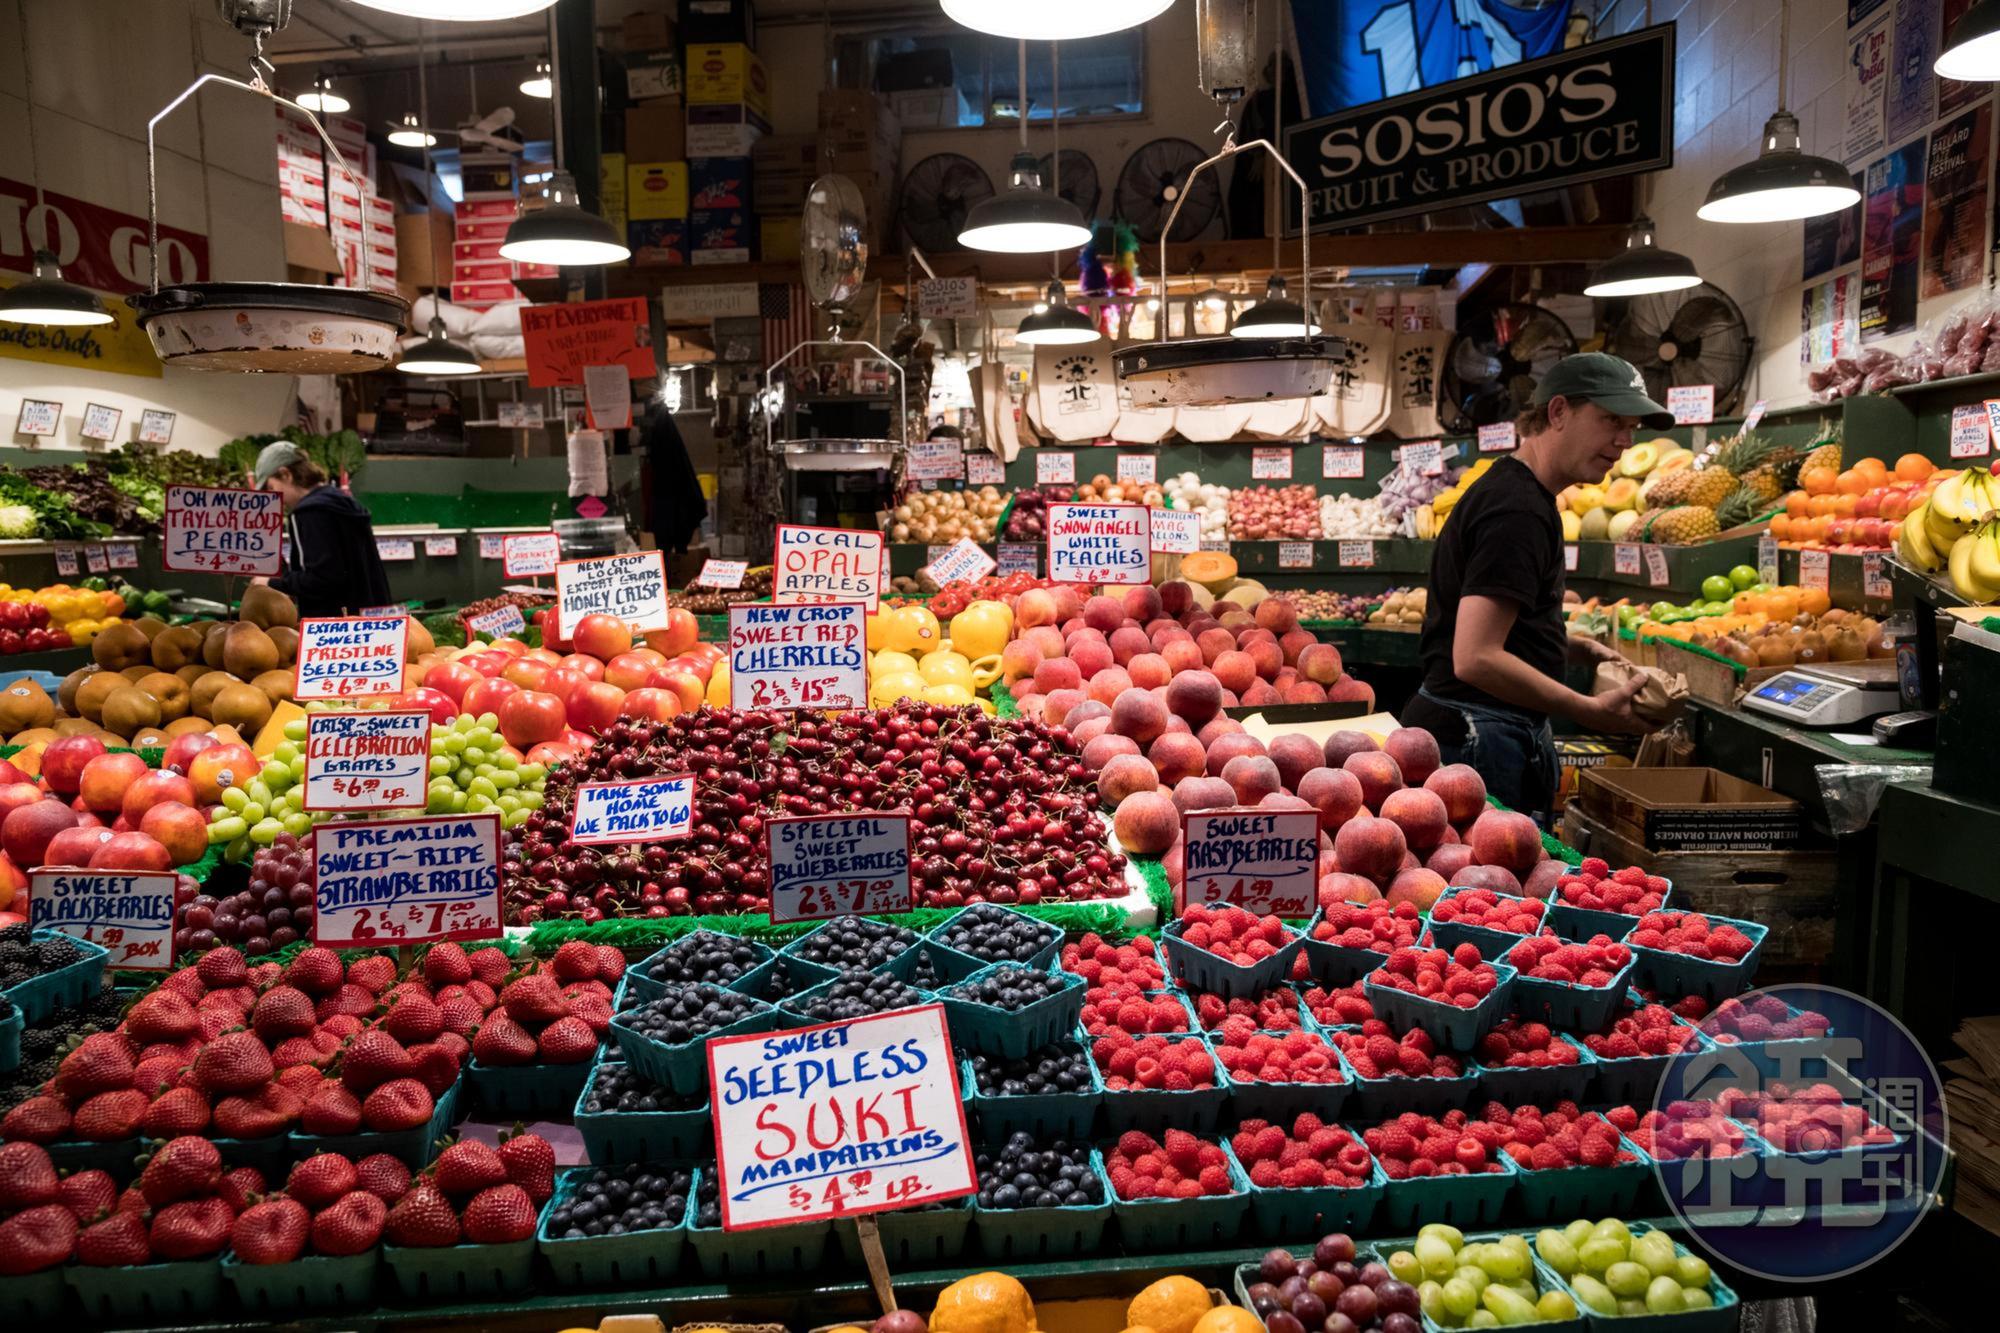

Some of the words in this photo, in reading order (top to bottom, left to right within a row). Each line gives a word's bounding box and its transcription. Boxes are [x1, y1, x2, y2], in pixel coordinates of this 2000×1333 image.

[1319, 61, 1617, 178] SOSIO'S
[1931, 127, 1969, 156] BALLARD
[1308, 171, 1405, 218] FRUIT
[1412, 167, 1438, 195] &
[1445, 120, 1641, 190] PRODUCE
[1929, 153, 1967, 181] FESTIVAL
[109, 226, 199, 287] GO
[212, 493, 237, 511] MY
[1066, 507, 1121, 518] SWEET
[167, 508, 238, 531] TAYLOR
[243, 511, 282, 536] GOLD
[1152, 511, 1198, 520] AGNIFICENT
[1053, 519, 1092, 536] SNOW
[1094, 520, 1146, 536] ANGEL
[182, 530, 264, 551] PEARS
[782, 530, 877, 549] LOCAL
[1068, 536, 1122, 548] WHITE
[577, 561, 605, 573] NEW
[611, 555, 646, 568] CROP
[785, 549, 877, 577] OPAL
[1052, 548, 1144, 566] PEACHES
[566, 577, 614, 595] EXPORT
[619, 568, 662, 586] GRADE
[588, 566, 634, 580] LOCAL
[786, 574, 870, 592] APPLES
[563, 590, 610, 613] HONEY
[615, 582, 662, 605] CRISP
[747, 608, 790, 623] NEW
[797, 607, 854, 621] CROP
[307, 622, 349, 635] EXTRA
[353, 619, 403, 632] CRISP
[733, 623, 808, 649] SWEET
[814, 624, 859, 647] RED
[316, 632, 374, 647] SWEET
[304, 643, 396, 662] PRISTINE
[734, 644, 862, 673] CHERRIES
[303, 659, 397, 677] SEEDLESS
[752, 679, 772, 707] 2
[310, 728, 430, 761] CELEBRATION
[324, 758, 396, 773] GRAPES
[1558, 755, 1605, 767] above
[382, 788, 410, 803] LB.
[586, 786, 633, 802] TAKE
[637, 780, 686, 799] SOME
[606, 796, 661, 816] HOME
[575, 818, 600, 835] WE
[606, 812, 650, 831] PACK
[652, 809, 669, 827] TO
[669, 805, 690, 825] GO
[781, 820, 888, 843] SPECIAL
[1206, 816, 1278, 839] SWEET
[332, 822, 477, 849] PREMIUM
[1653, 830, 1705, 840] ORANGES
[1680, 842, 1729, 851] California
[1707, 830, 1742, 840] NAVEL
[1729, 842, 1773, 851] Premium
[1743, 830, 1799, 840] HEIRLOOM
[794, 838, 862, 861] SWEET
[1186, 838, 1319, 875] RASPBERRIES
[771, 849, 909, 892] BLUEBERRIES
[53, 876, 139, 897] SWEET
[317, 865, 499, 909] STRAWBERRIES
[798, 885, 818, 914] 2
[818, 886, 837, 912] FOR
[1266, 895, 1308, 914] BOX
[31, 895, 175, 930] BLACKBERRIES
[352, 908, 376, 939] 2
[380, 911, 408, 937] FOR
[119, 939, 163, 963] BOX
[763, 1024, 853, 1061] SWEET
[724, 1038, 928, 1106] SEEDLESS
[754, 1084, 928, 1160] SUKI
[741, 1129, 945, 1186] MANDARINS
[886, 1175, 933, 1201] LB.
